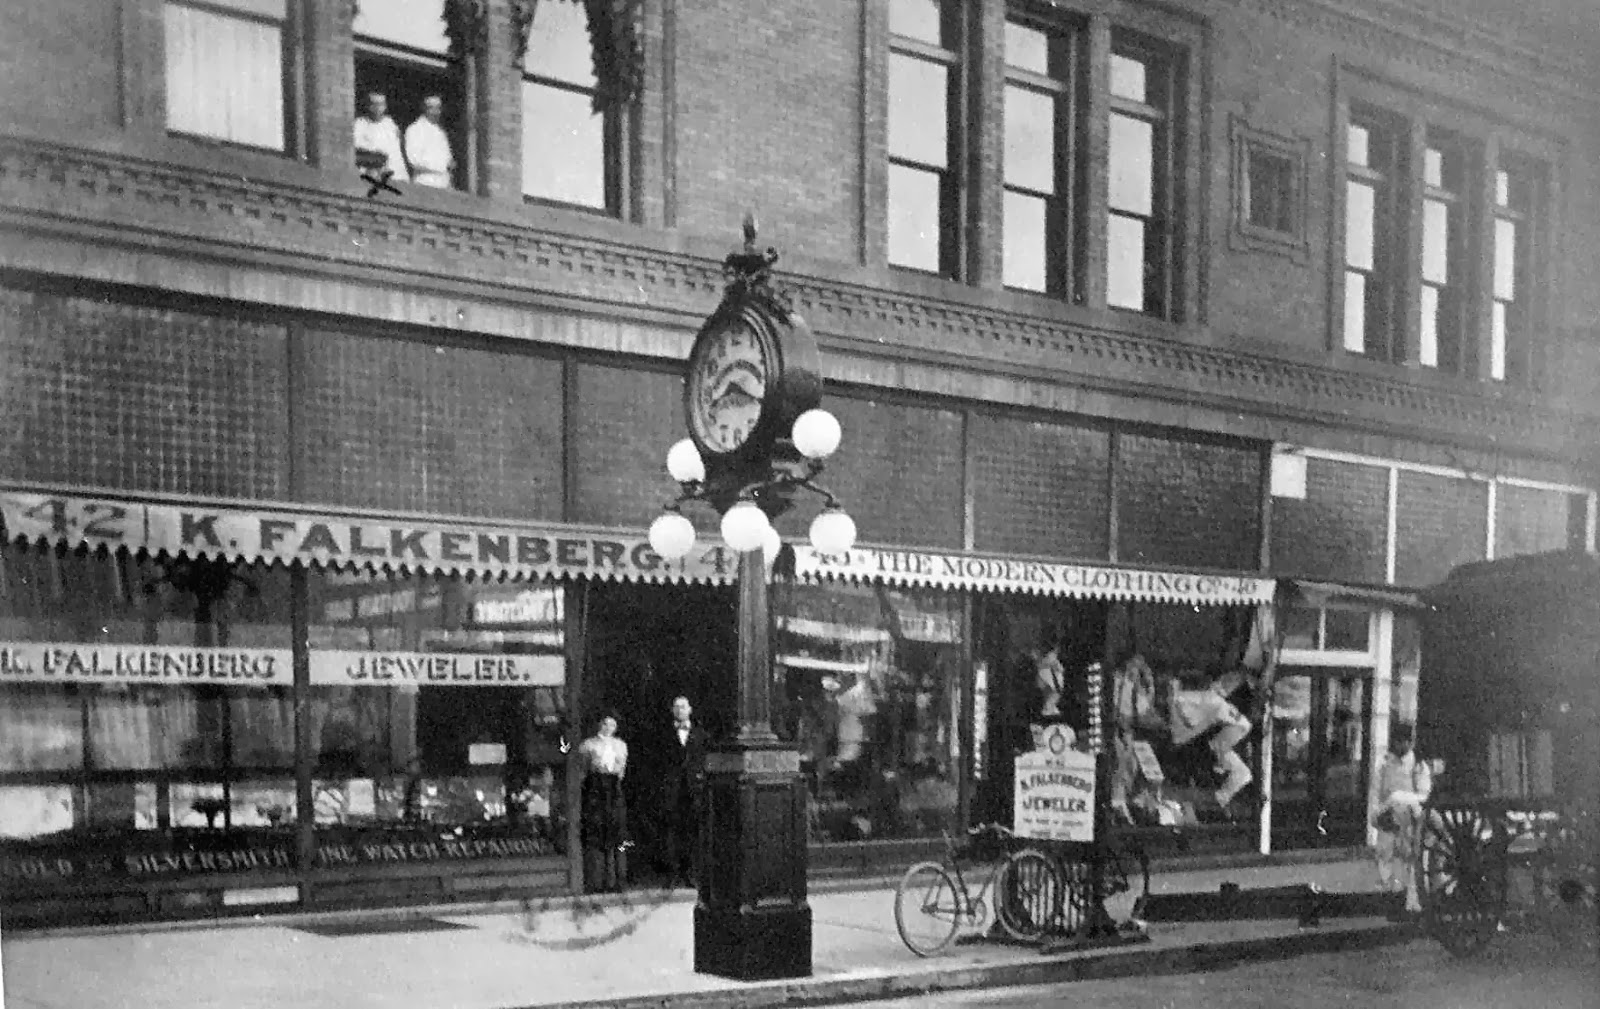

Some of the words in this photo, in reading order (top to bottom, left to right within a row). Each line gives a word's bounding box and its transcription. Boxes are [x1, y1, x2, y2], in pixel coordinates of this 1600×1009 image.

[22, 498, 127, 539] 42
[871, 550, 933, 576] THE
[942, 556, 1056, 583] MODERN
[1062, 567, 1191, 595] CLOTHING
[43, 649, 276, 679] FALKENBERG
